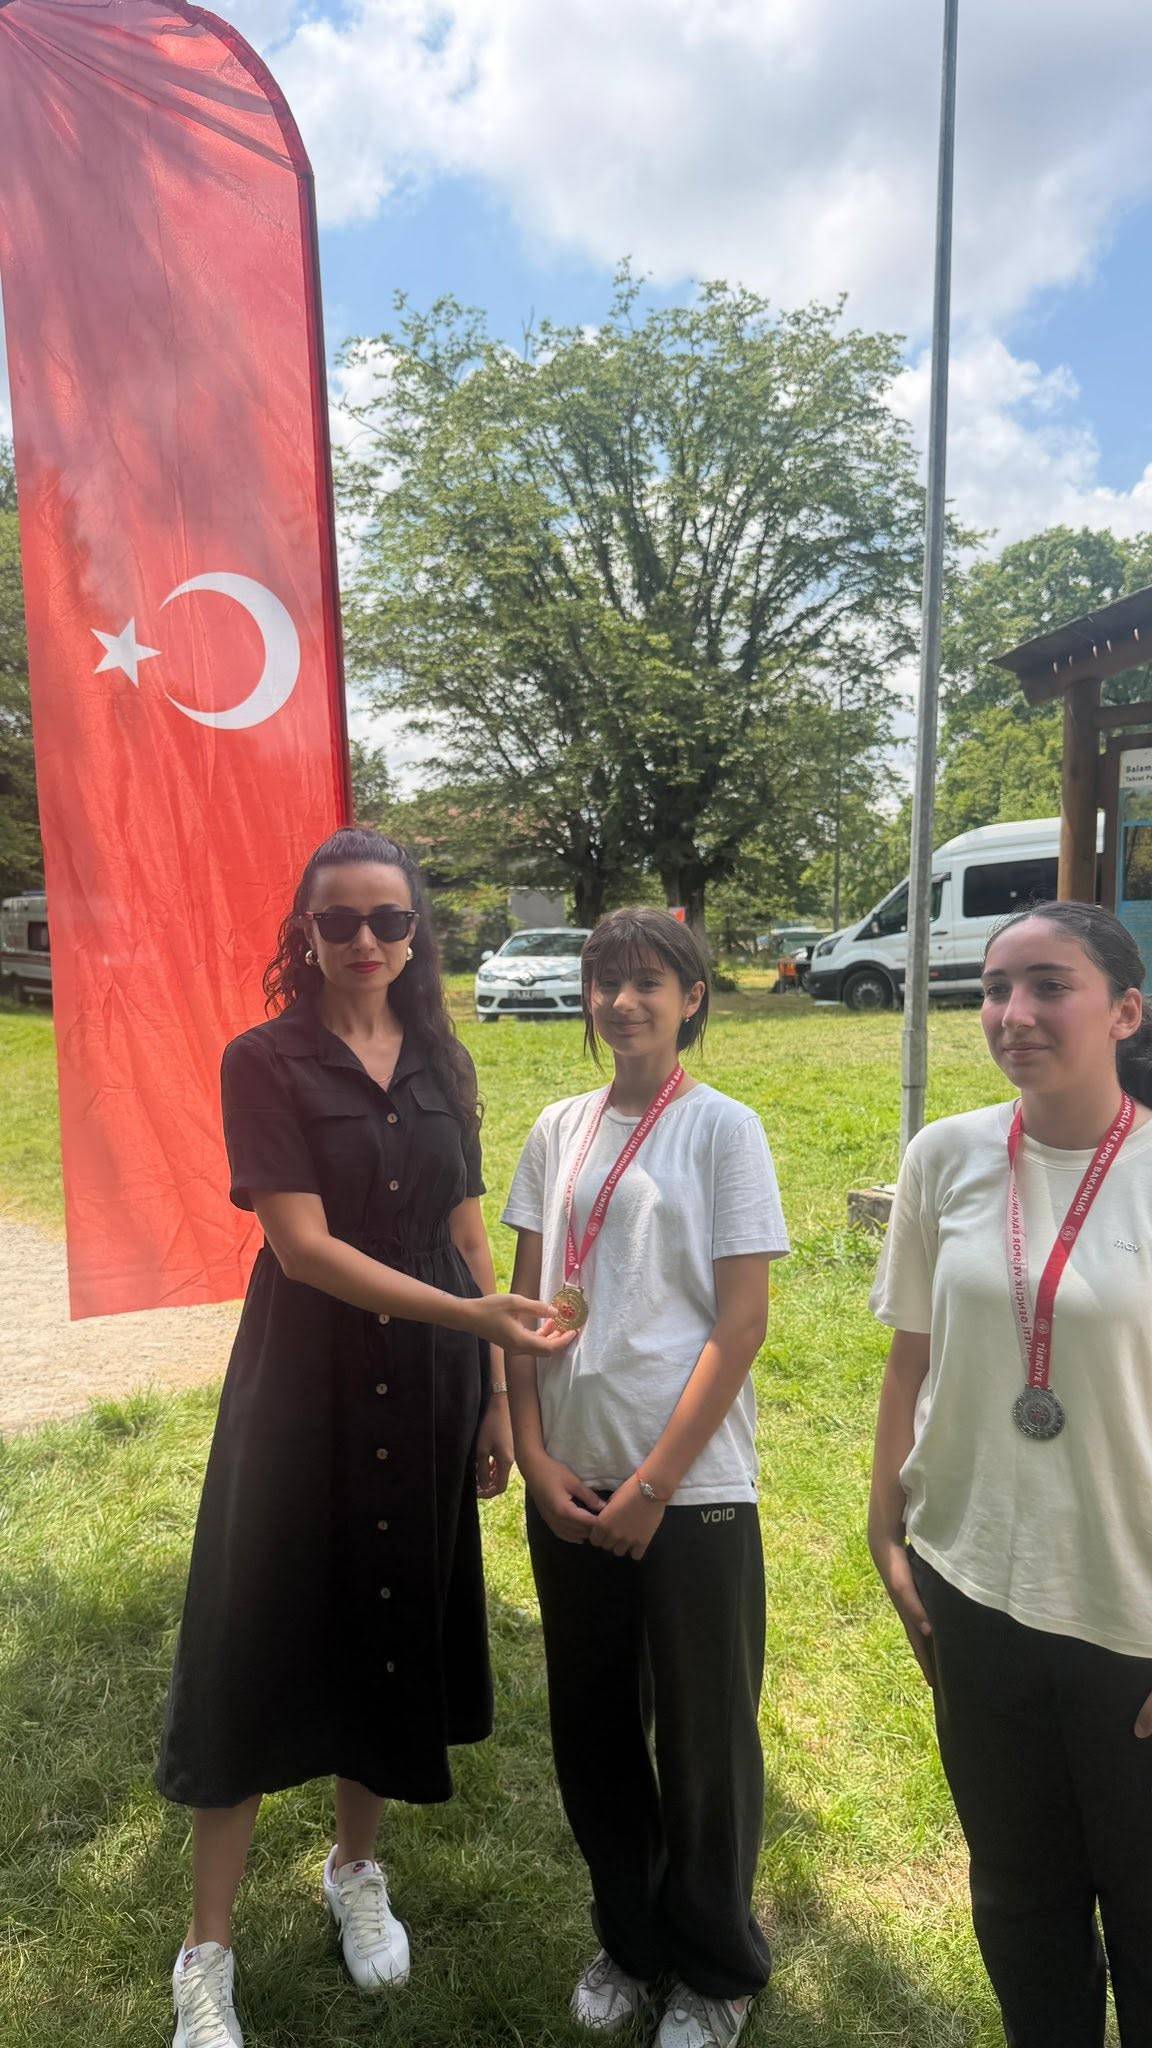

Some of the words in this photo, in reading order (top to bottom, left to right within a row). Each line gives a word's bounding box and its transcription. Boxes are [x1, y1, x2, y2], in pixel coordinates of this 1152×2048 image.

[655, 1097, 665, 1108] VE
[1110, 1129, 1121, 1142] VE
[1098, 1142, 1114, 1166] SPOR
[1073, 1165, 1103, 1216] BAKANLIĞI
[1034, 1341, 1046, 1382] TÜRKİYE
[701, 1508, 735, 1523] VOID
